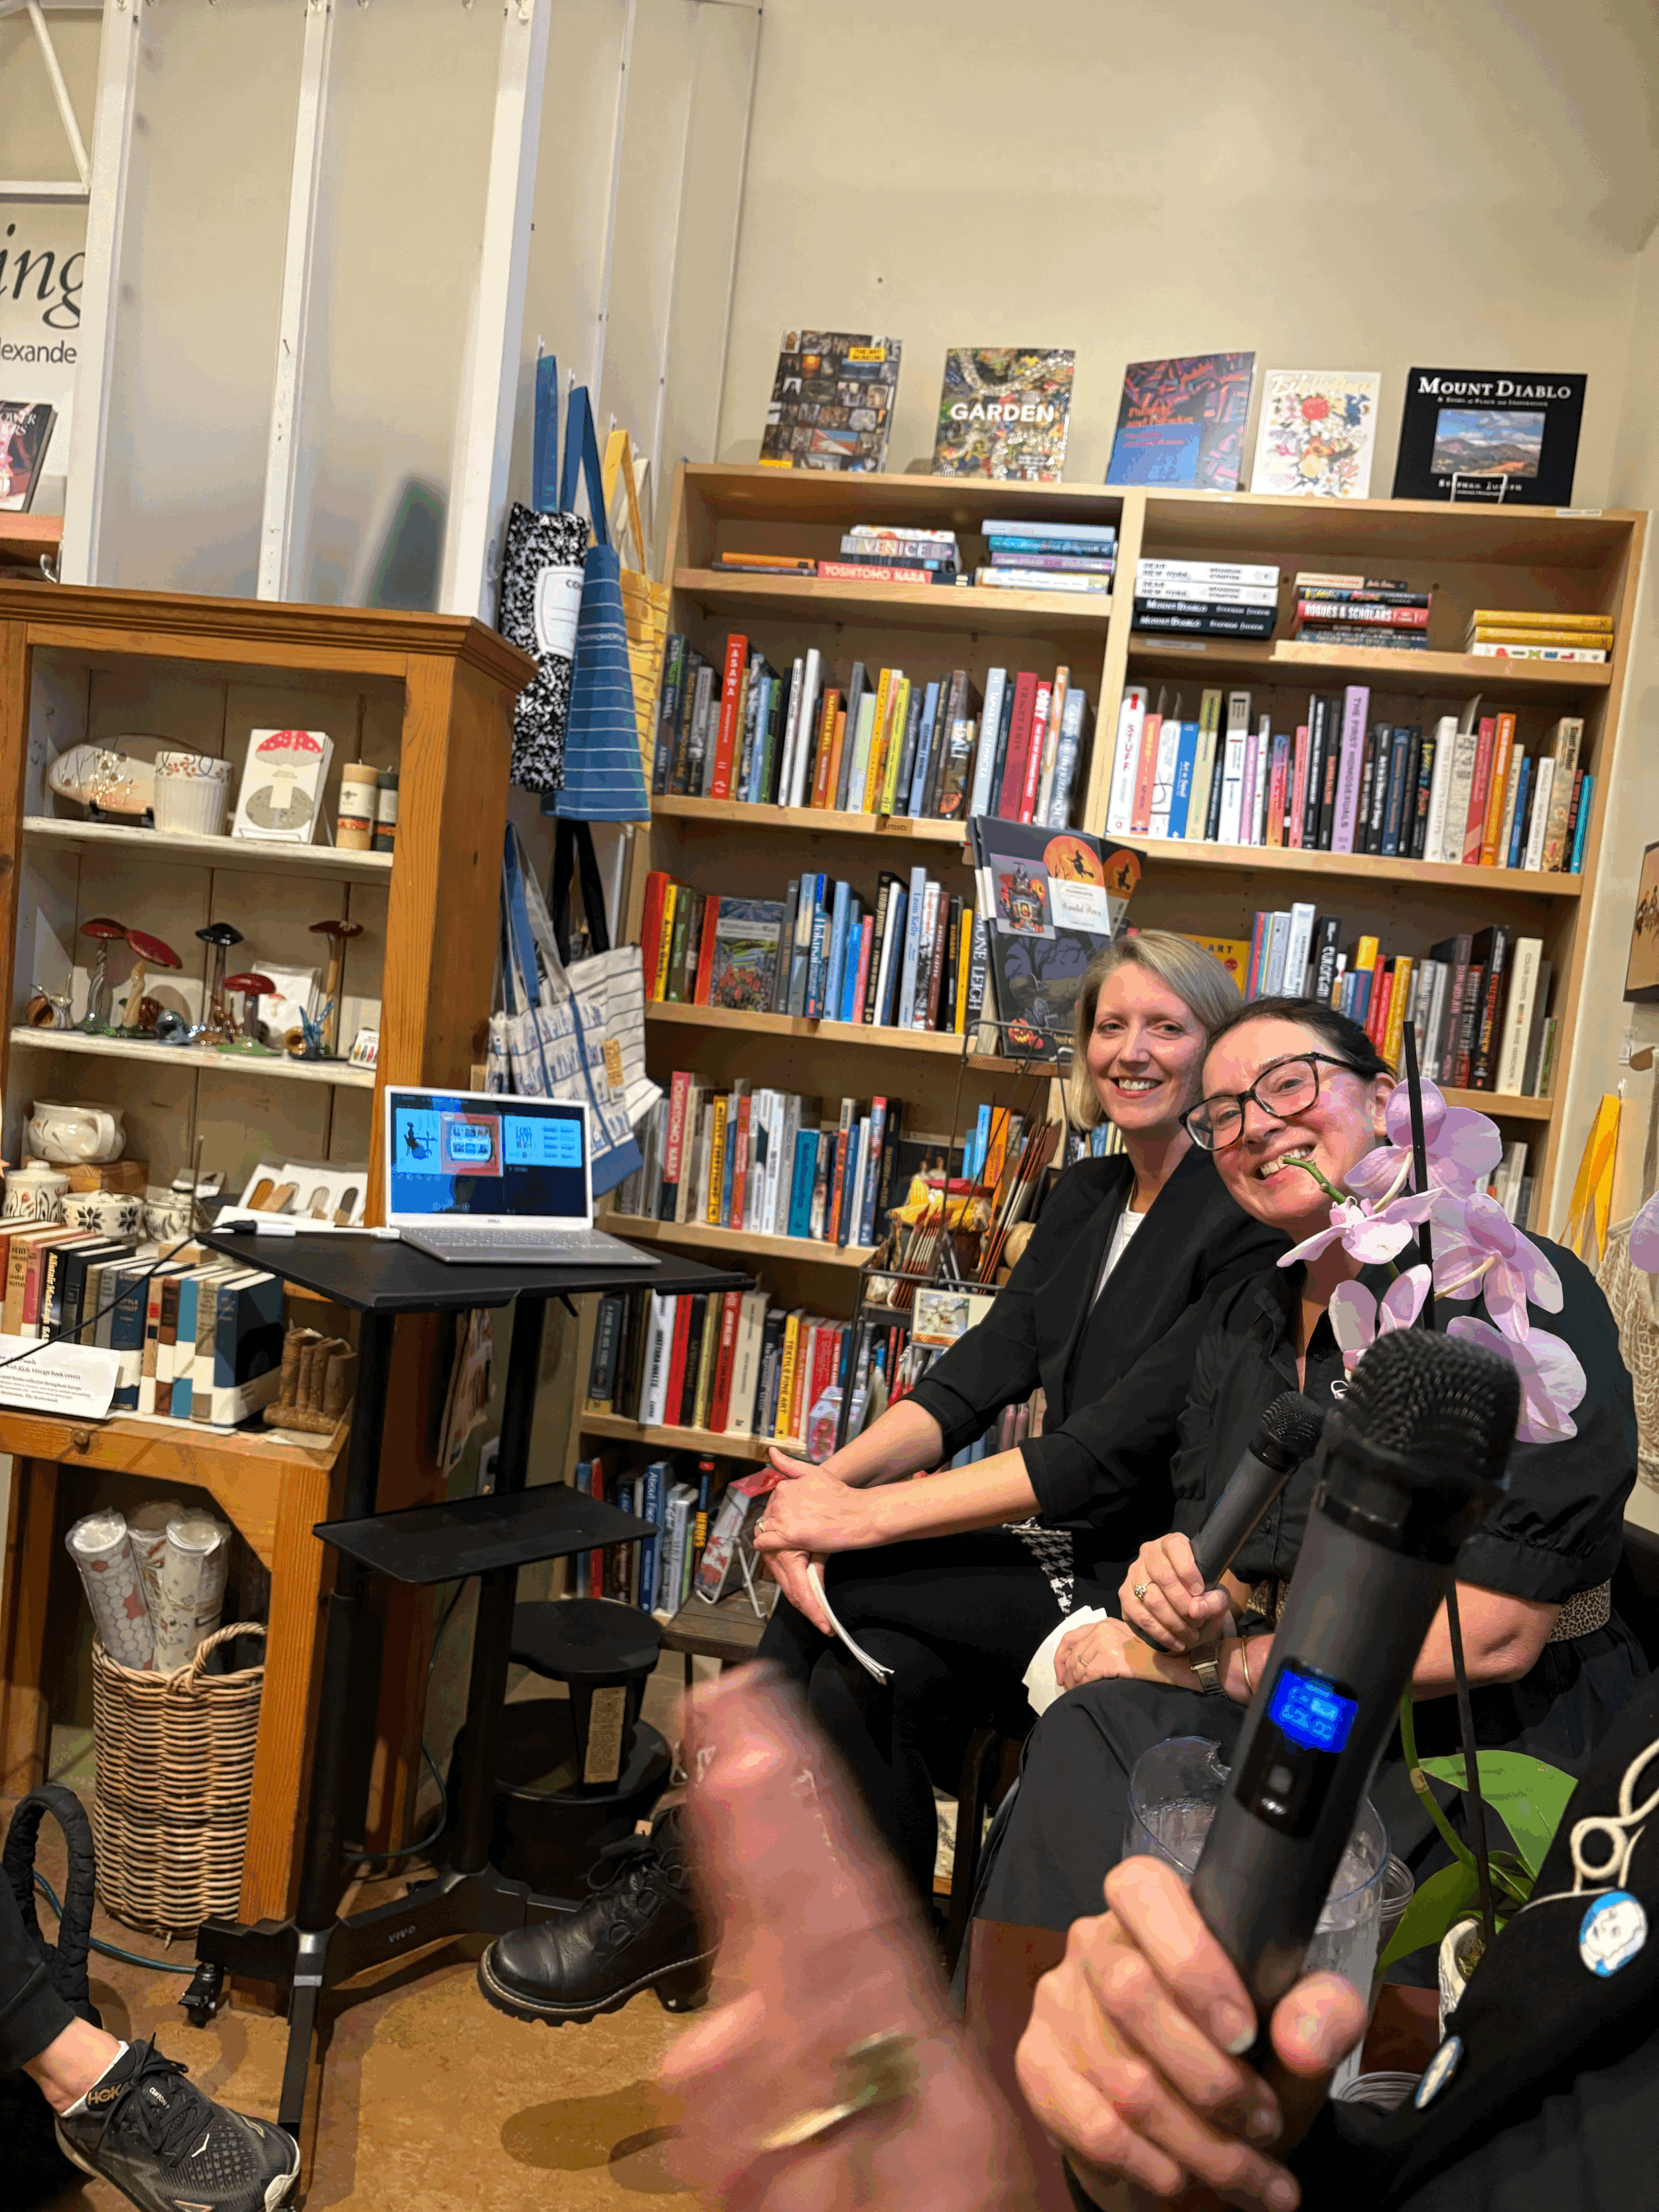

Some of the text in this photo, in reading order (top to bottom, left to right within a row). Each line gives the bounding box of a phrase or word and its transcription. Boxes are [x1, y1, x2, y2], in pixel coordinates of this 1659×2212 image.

[1417, 376, 1571, 399] MOUNT DIABLO
[950, 402, 1054, 422] GARDEN
[863, 540, 927, 557] VENICE
[662, 687, 674, 719] CHANEL
[1035, 688, 1050, 719] OBEY
[1352, 697, 1362, 717] THE
[1349, 719, 1360, 748] FIRST
[909, 893, 921, 936] Leon Kelly
[968, 966, 985, 1010] LEIGH
[670, 1079, 684, 1143] YOSHITOMO
[47, 1252, 58, 1285] Alistair
[43, 1284, 55, 1324] MacLean
[779, 1341, 794, 1414] TEXTILE FINE ART
[647, 1472, 658, 1499] About
[695, 1512, 708, 1548] HEROES
